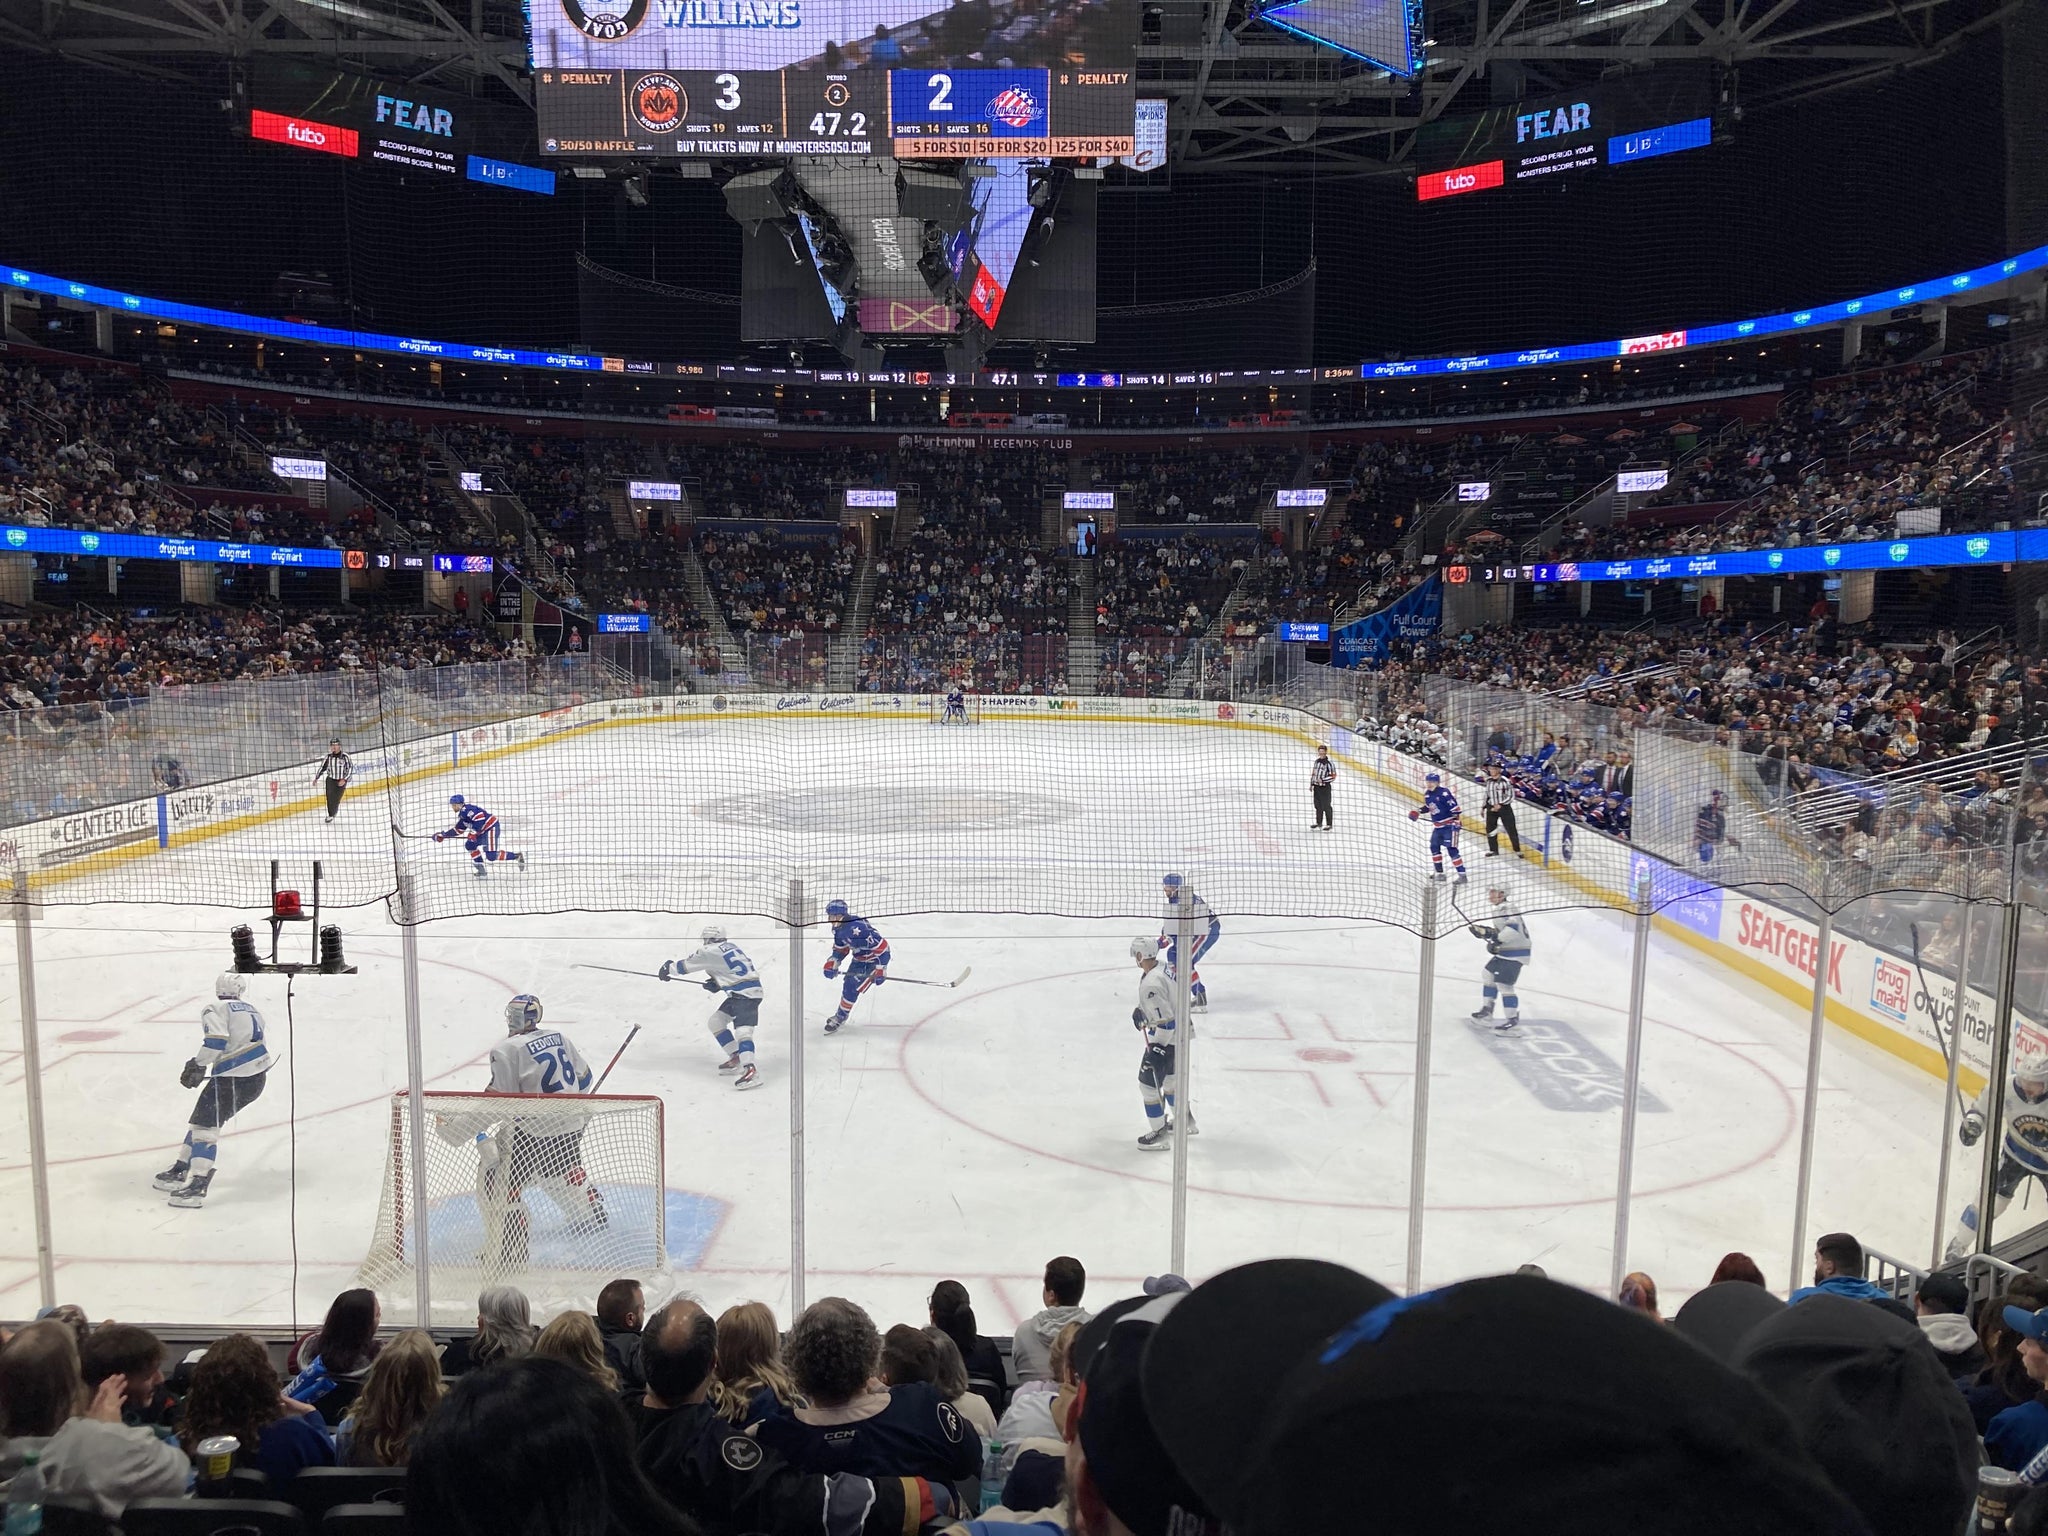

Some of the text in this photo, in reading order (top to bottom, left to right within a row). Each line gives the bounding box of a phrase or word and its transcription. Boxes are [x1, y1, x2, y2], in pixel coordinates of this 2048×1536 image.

[657, 1, 801, 27] WILLIAMS
[583, 16, 629, 38] GOAL
[561, 73, 612, 85] PENALTY
[1078, 73, 1129, 85] PENALTY
[714, 73, 741, 111] 3
[833, 89, 841, 100] 2
[927, 73, 953, 111] 2
[985, 97, 1045, 121] Americans
[376, 95, 454, 137] FEAR
[640, 116, 679, 131] MONSTERS
[686, 123, 773, 134] SHOTS 19 SAVES 12
[809, 112, 867, 136] 47.2
[896, 124, 989, 134] SHOTS 14 SAVES 16
[1516, 102, 1592, 144] FEAR
[287, 123, 325, 145] fubo
[379, 140, 454, 161] SECOND YOUR
[560, 141, 593, 151] 50/50
[595, 141, 635, 152] RAFFLE
[677, 140, 871, 154] BUY TICKETS NOW AT MONSTERS5050.COM
[913, 141, 971, 154] 5 FOR $10
[979, 141, 1047, 154] 50 FOR $20
[1055, 141, 1129, 154] 125 FOR $40
[373, 151, 410, 165] MONSTERS
[411, 158, 433, 169] SCORE
[1521, 145, 1594, 165] SECOND YOUR
[1517, 166, 1551, 178] MONSTERS
[1552, 161, 1574, 172] SCORE
[1444, 174, 1476, 191] fubo
[871, 218, 898, 244] Arena
[400, 340, 420, 352] drug
[421, 343, 442, 353] mart
[473, 349, 516, 361] drug mart
[546, 355, 589, 367] drug mart
[1517, 350, 1560, 363] drug mart
[627, 362, 653, 371] oswald
[676, 365, 703, 375] $5,980
[1375, 364, 1417, 375] drug mart
[1447, 358, 1489, 371] drug mart
[820, 372, 859, 382] SHOTS 19
[868, 373, 906, 383] SAVES 12
[946, 374, 956, 385] 3
[991, 374, 1018, 385] 47.1
[1077, 374, 1086, 386] 2
[1126, 375, 1165, 385] SHOTS 14
[1175, 373, 1213, 384] SAVES 16
[293, 464, 324, 475] CLIFFS
[650, 487, 679, 496] CLIFFS
[865, 494, 895, 502] CLIFFS
[1296, 493, 1324, 502] CLIFFS
[1082, 497, 1111, 506] CLIFFS
[159, 542, 195, 558] drug mart
[219, 546, 251, 561] drug mart
[271, 551, 286, 563] drug
[377, 554, 390, 568] 19
[404, 558, 423, 567] SHOTS
[1485, 569, 1493, 580] 3
[1540, 568, 1547, 579] 2
[607, 615, 639, 624] SHERWIN
[1393, 614, 1436, 626] Full Court
[1289, 623, 1319, 632] SHERWIN
[1400, 626, 1428, 637] Power
[1338, 638, 1379, 646] COMCAST
[776, 694, 812, 710] Culver's
[820, 694, 855, 711] Culver's
[989, 698, 1026, 707] HAPPEN
[1263, 710, 1290, 723] CLIFFS
[63, 804, 148, 843] CENTER ICE
[1737, 902, 1848, 995] SEATGEEK
[1877, 963, 1904, 995] drug
[1876, 988, 1906, 1013] mart
[1942, 986, 1980, 1014] DISOUNT
[1963, 1012, 1996, 1046] mar
[824, 1429, 856, 1441] CCM
